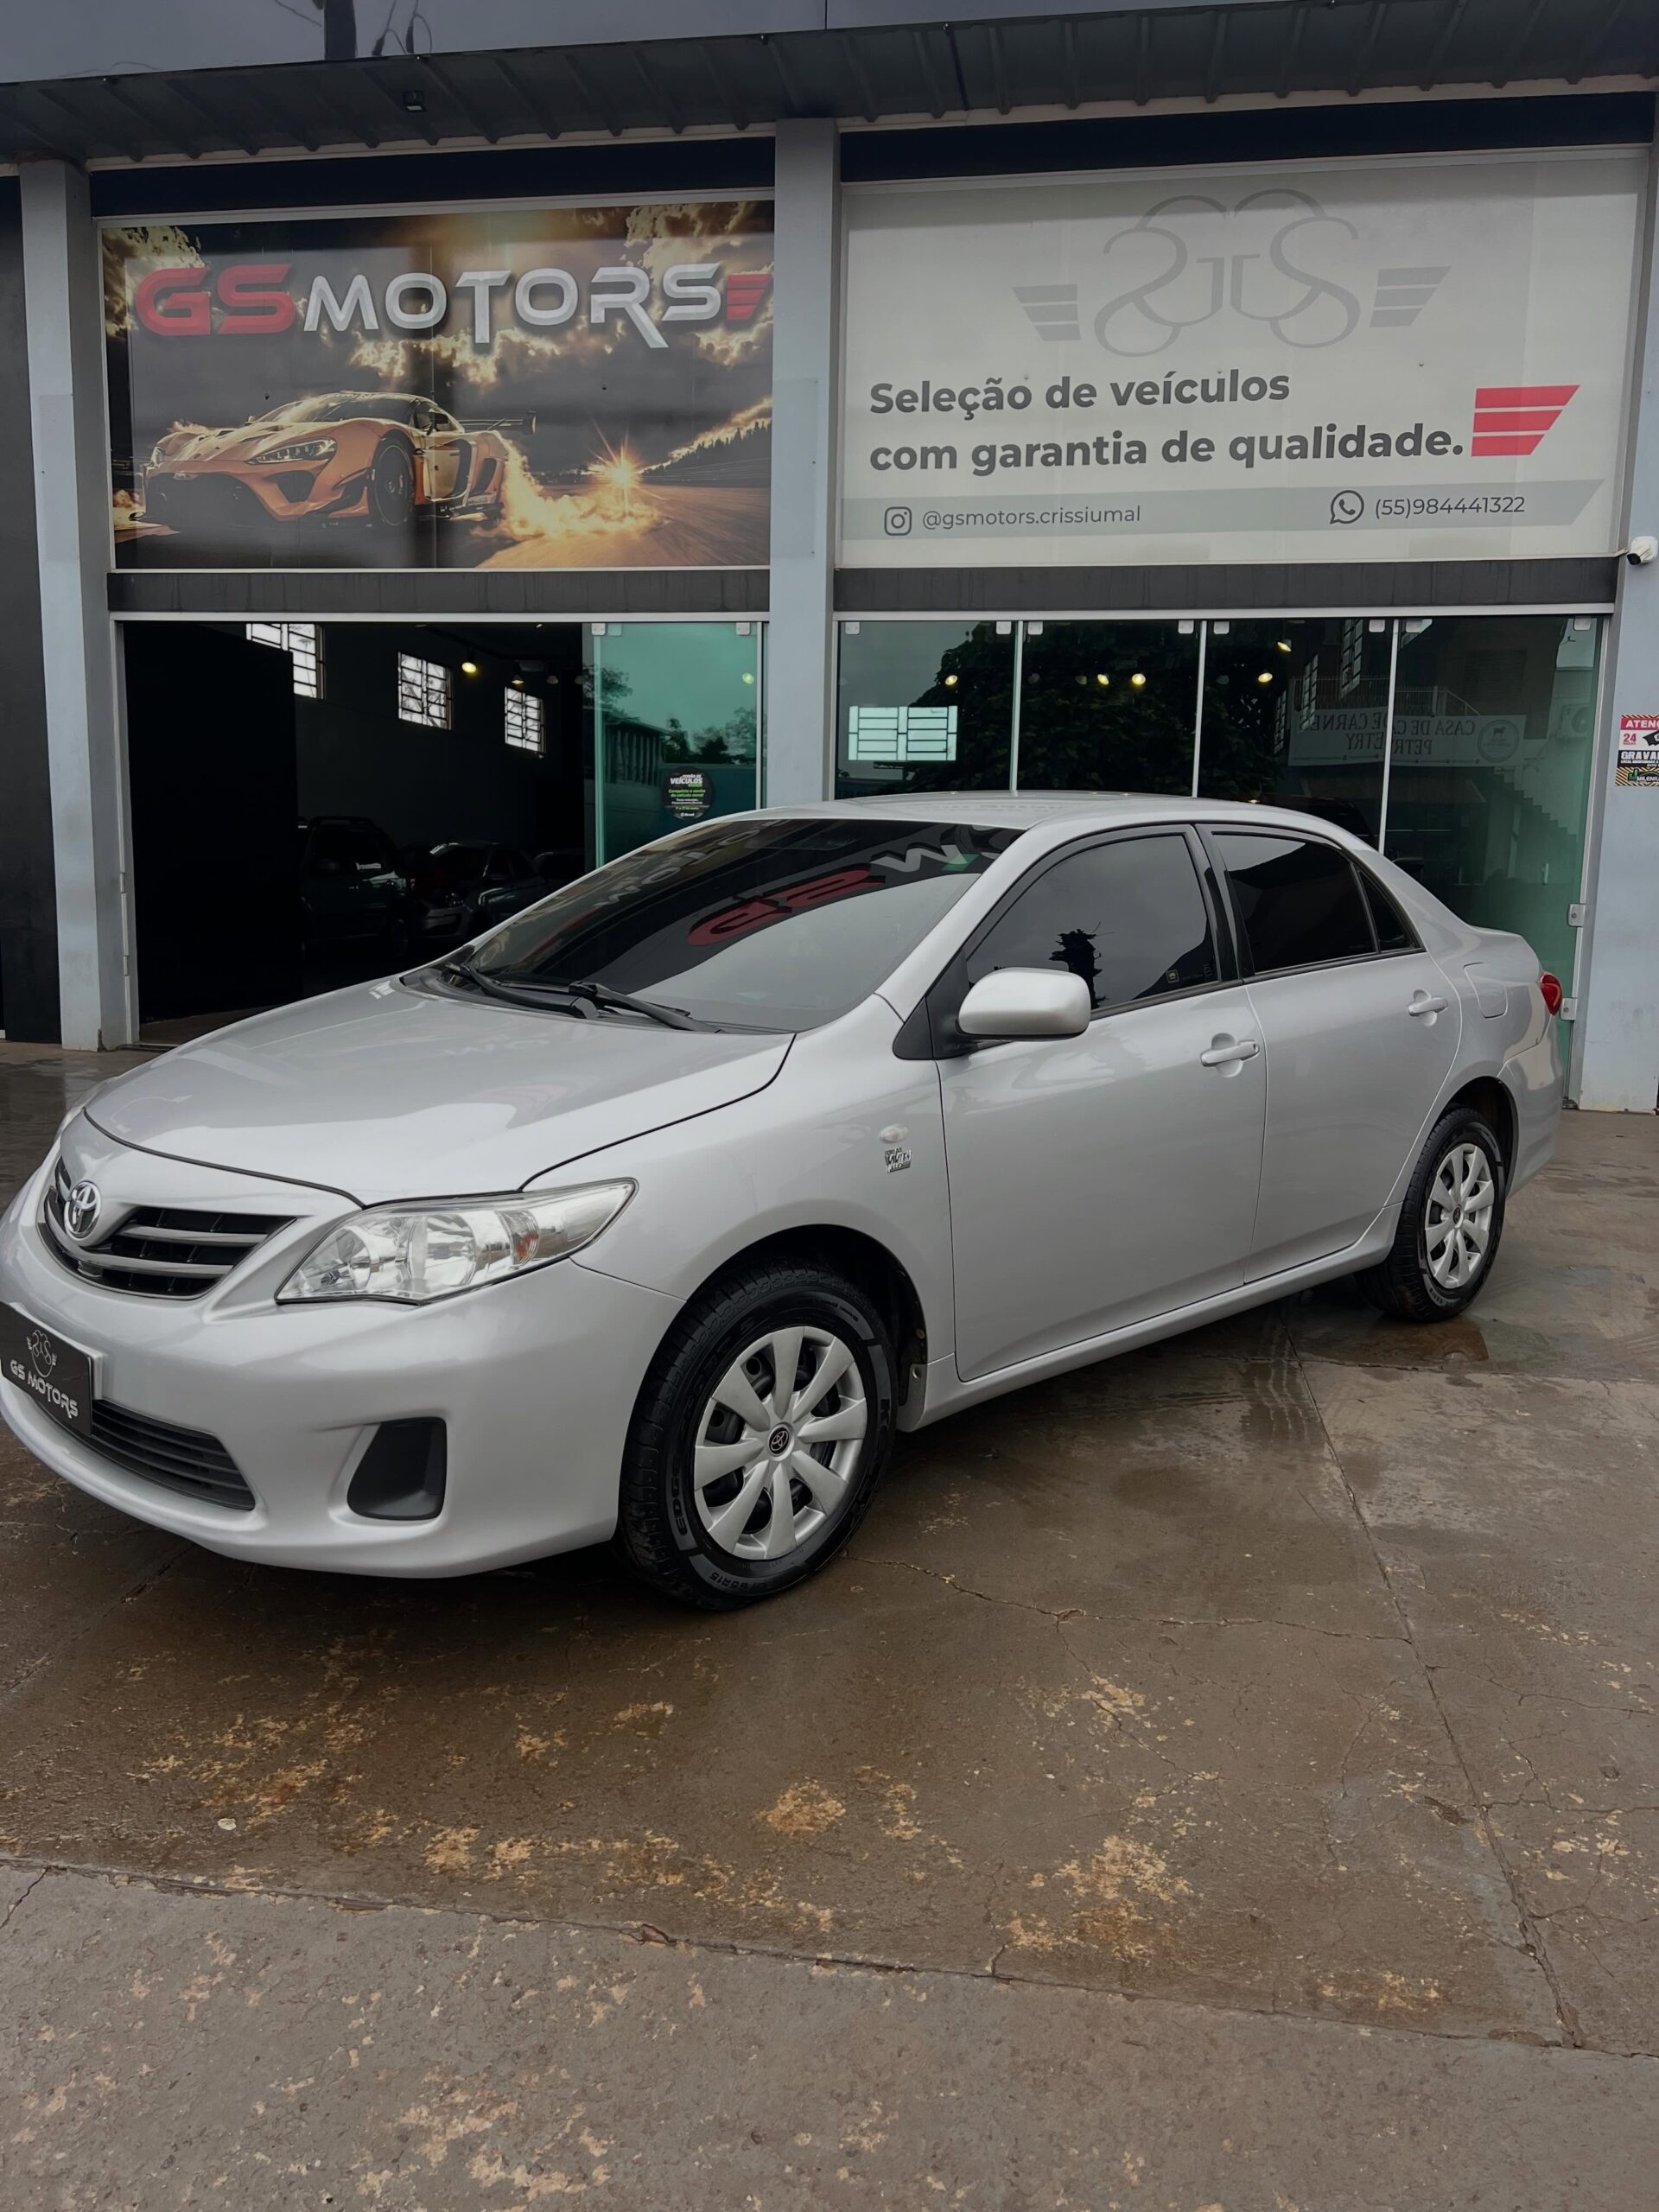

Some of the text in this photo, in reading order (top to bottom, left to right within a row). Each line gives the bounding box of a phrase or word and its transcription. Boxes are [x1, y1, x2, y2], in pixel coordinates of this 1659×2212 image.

[870, 369, 1290, 421] Seleção de veículos
[869, 423, 1464, 477] com garantia de qualidade.
[922, 505, 1141, 531] @gsmotors.crissiumal
[1376, 496, 1526, 519] (55)984441322
[1623, 733, 1637, 742] 24
[10, 1359, 79, 1419] GS MOTORS
